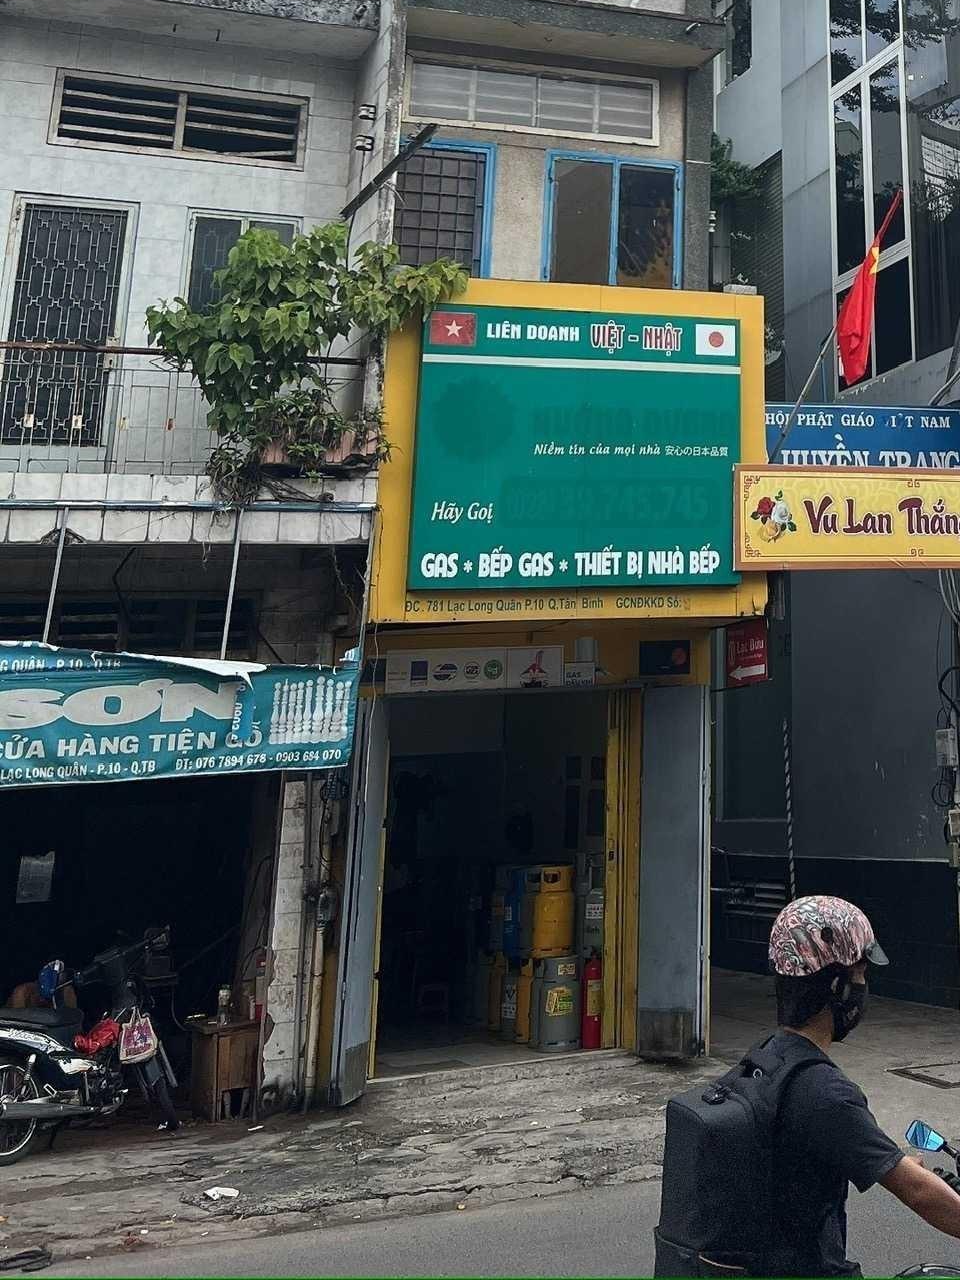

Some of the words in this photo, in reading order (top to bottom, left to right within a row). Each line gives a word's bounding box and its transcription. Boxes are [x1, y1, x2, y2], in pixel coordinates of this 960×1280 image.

[486, 321, 521, 339] LIÊN
[527, 324, 580, 342] DOANH
[590, 320, 625, 354] VIỆT
[643, 322, 683, 356] NHẬT
[797, 412, 834, 429] PHẬT
[841, 412, 874, 426] GIÁO
[921, 416, 950, 428] NAM
[534, 441, 564, 455] Niềm
[569, 443, 585, 455] tin
[589, 443, 610, 455] của
[614, 443, 635, 457] mọi
[639, 443, 661, 455] nhà
[431, 501, 463, 524] Hãy
[803, 495, 838, 534] Vu
[843, 498, 892, 534] Lan
[421, 552, 459, 578] GAS
[478, 545, 513, 577] BẾP
[518, 552, 554, 576] GAS
[574, 544, 622, 576] THIẾT
[627, 551, 643, 579] BỊ
[648, 546, 684, 574] NHÀ
[689, 543, 720, 574] BẾP
[427, 600, 444, 612] 781
[448, 600, 465, 614] Lạc
[468, 600, 493, 614] Long
[496, 599, 522, 612] Quân
[525, 599, 544, 611] P.10
[616, 597, 664, 609] GCNĐKKD
[57, 733, 140, 758] HÀNG
[150, 728, 216, 754] TIỆN
[1, 769, 23, 781] LẠC
[26, 767, 54, 779] LONG
[57, 762, 88, 776] QUÂN
[97, 763, 121, 776] P.10
[131, 760, 156, 773] Q.TB
[176, 757, 192, 770] ĐT:
[196, 757, 215, 769] 076
[218, 755, 244, 768] 7894
[246, 753, 266, 765] 678
[276, 751, 300, 762] 0903
[323, 749, 341, 760] 070
